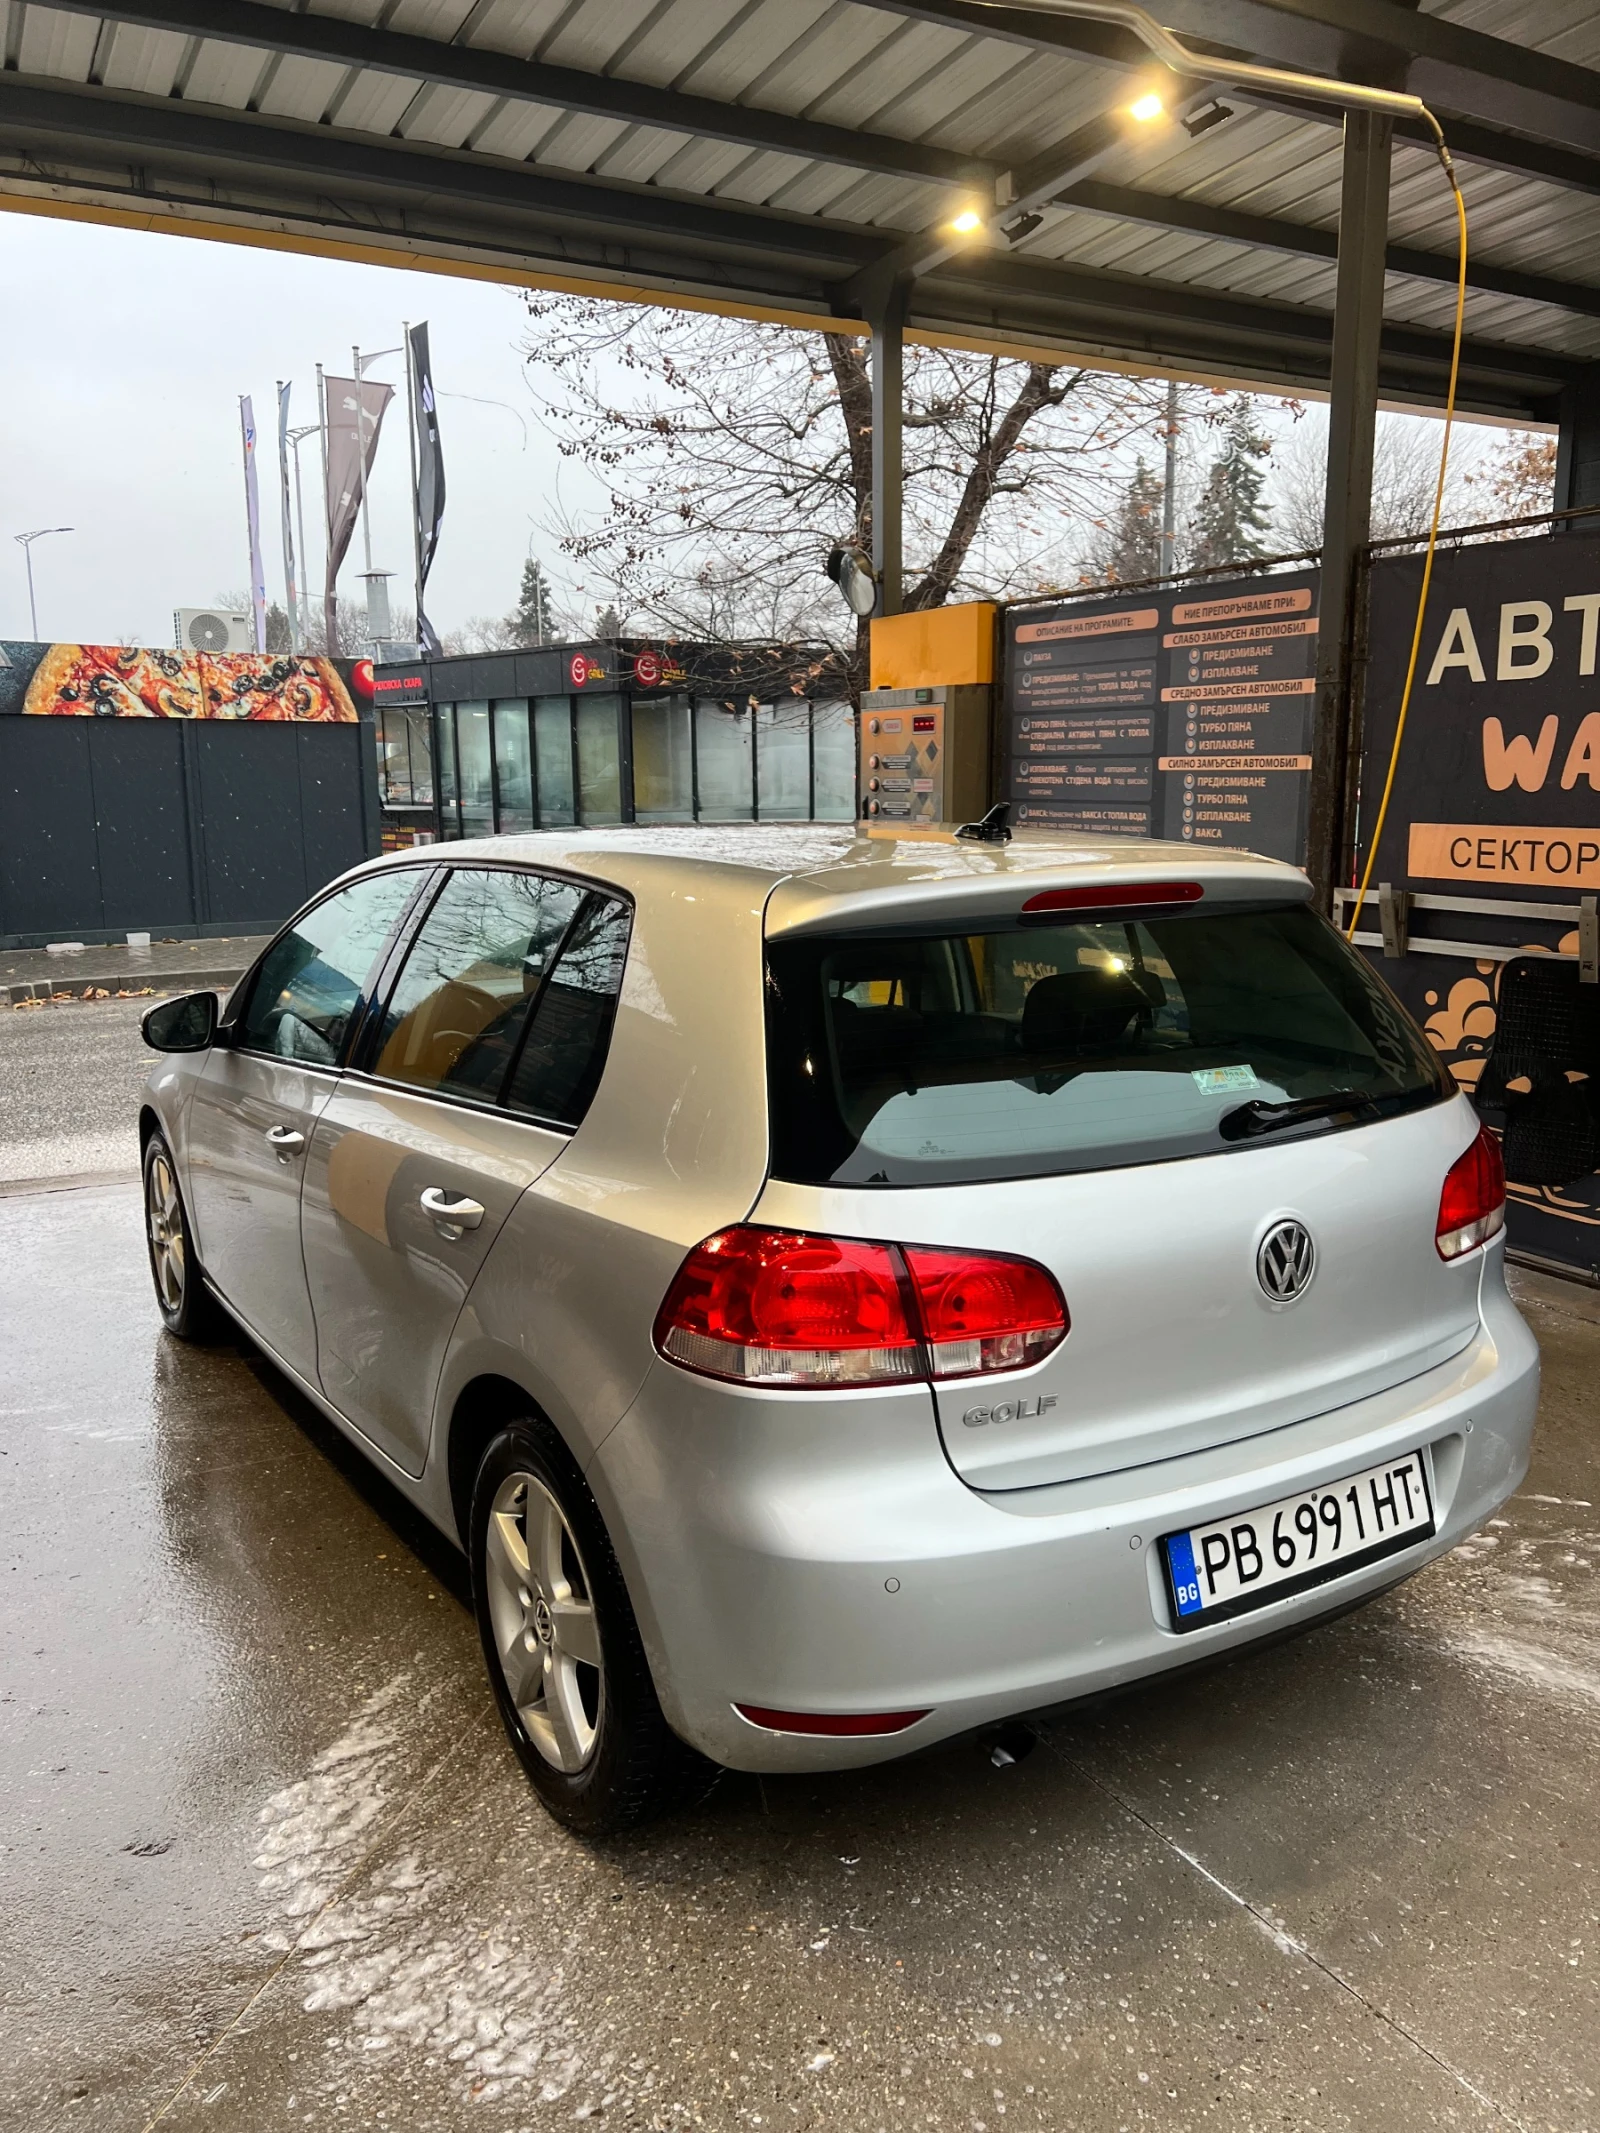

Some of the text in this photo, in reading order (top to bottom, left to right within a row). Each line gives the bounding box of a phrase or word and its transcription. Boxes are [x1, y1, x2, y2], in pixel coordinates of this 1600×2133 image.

[1184, 596, 1296, 620] НИЕ ПРЕПОРЪЧВАМЕ ПРИ:
[1036, 617, 1134, 637] ОПИСАНИЕ НА ПРОГРАМИТЕ:
[1172, 622, 1306, 645] СЛАБО ЗАМЪРСЕН АВТОМОБИЛ
[1202, 646, 1273, 662] ПРЕДИЗМИВАНЕ
[1202, 665, 1259, 678] ИЗПЛАКВАНЕ
[1120, 681, 1139, 691] ВОДА
[1170, 682, 1302, 699] СРЕДНО ЗАМЪРСЕН АВТОМОБИЛ
[1200, 703, 1270, 716] ПРЕДИЗМИВАНЕ
[1200, 722, 1252, 732] ТУРБО ПЯНА
[1199, 740, 1255, 750] ИЗПЛАКВАНЕ
[1483, 712, 1600, 792] WA
[1168, 758, 1298, 769] СИЛНО ЗАМЪРСЕН АВТОМОБИЛ
[1198, 777, 1266, 788] ПРЕДИЗМИВАНЕ
[1197, 794, 1248, 804] ТУРБО ПЯНА
[1196, 812, 1251, 822] ИЗПЛАКВАНЕ
[1196, 828, 1222, 838] ВАКСА
[1450, 838, 1600, 875] СЕКТОР
[963, 1392, 1058, 1428] GOLF
[1201, 1464, 1414, 1595] PB 6991 HT
[1177, 1582, 1198, 1605] BG
